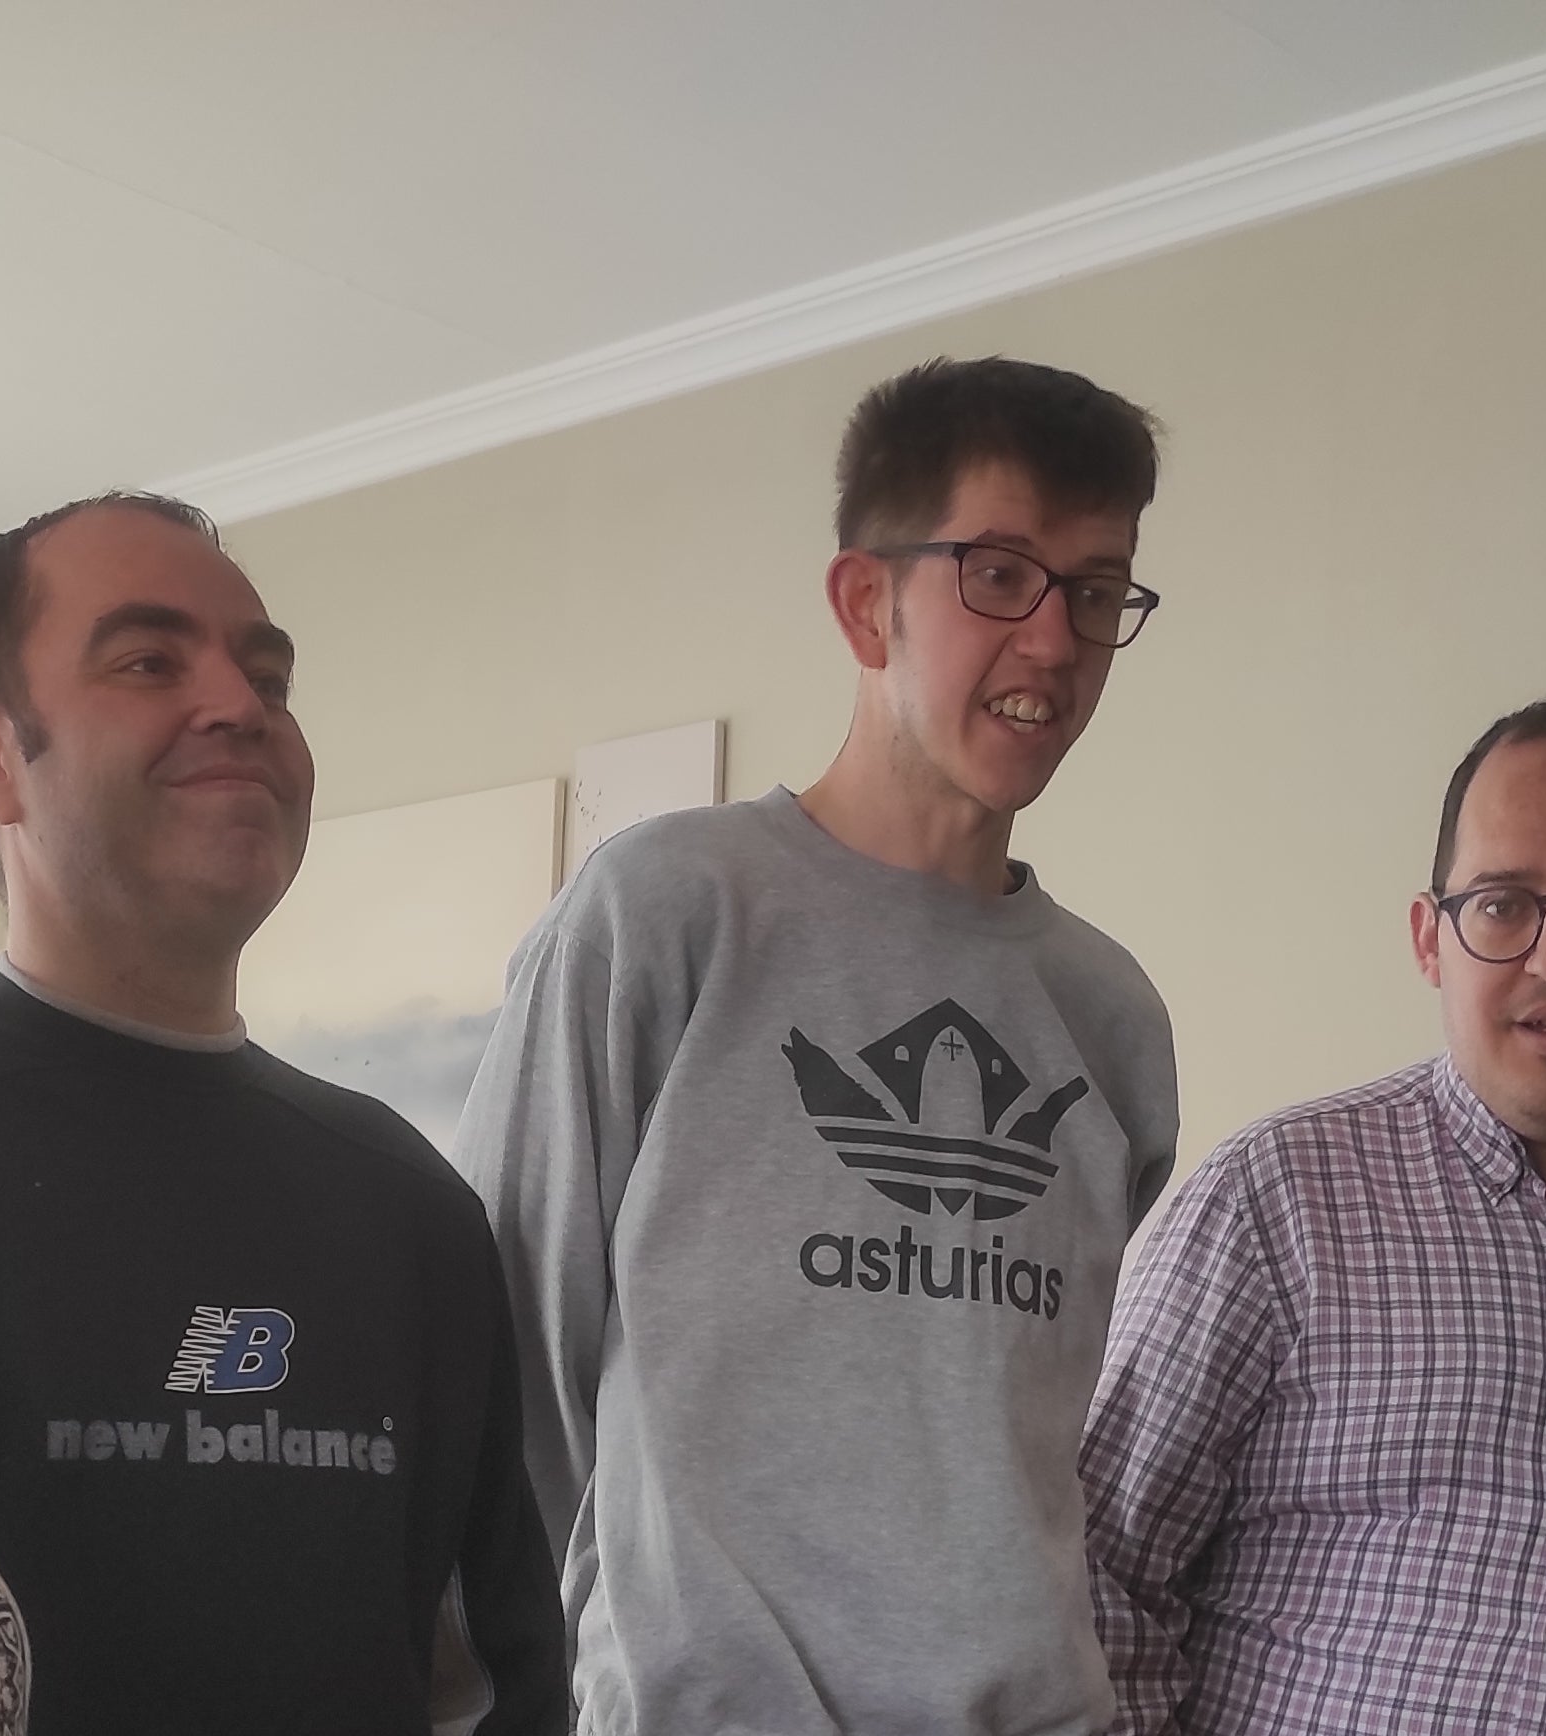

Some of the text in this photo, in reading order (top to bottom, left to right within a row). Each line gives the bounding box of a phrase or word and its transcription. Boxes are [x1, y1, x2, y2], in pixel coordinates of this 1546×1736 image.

[799, 1225, 1063, 1320] asturias
[47, 1408, 396, 1475] new balance
